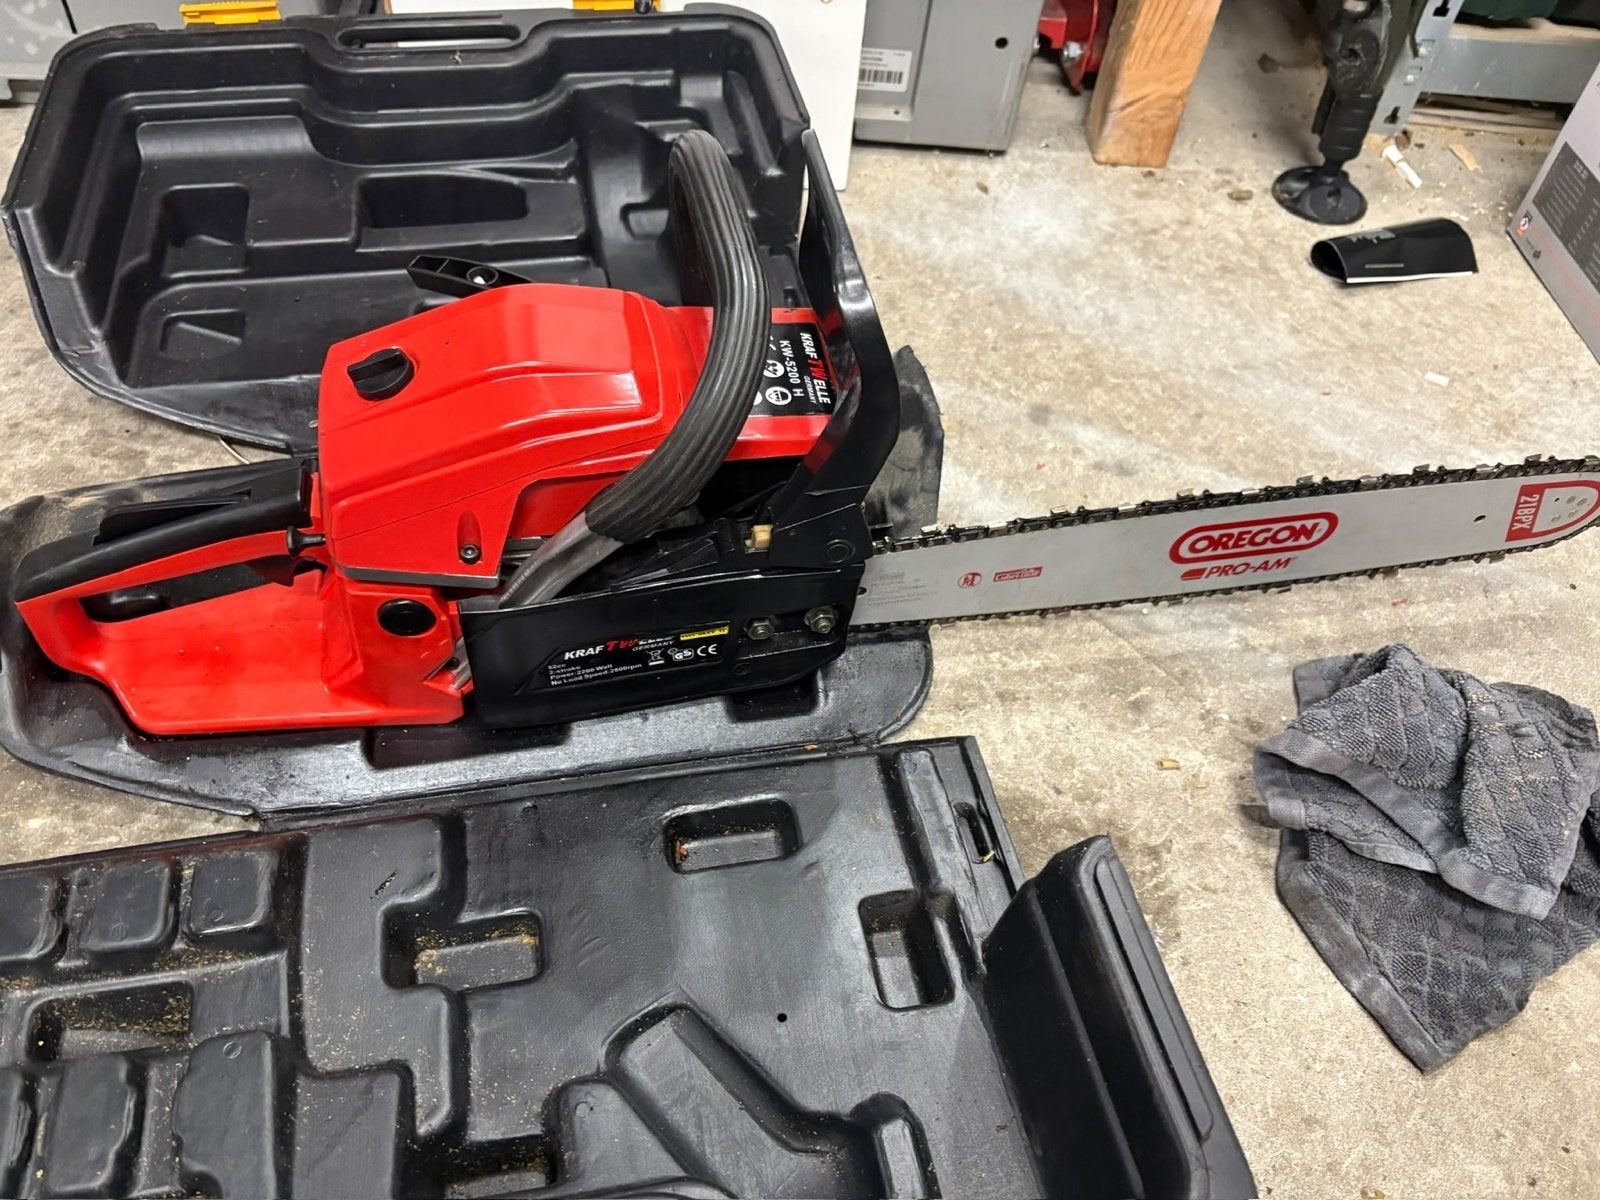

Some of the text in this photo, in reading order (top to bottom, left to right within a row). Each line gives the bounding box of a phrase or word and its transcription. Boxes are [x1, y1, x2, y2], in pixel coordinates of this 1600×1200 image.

[779, 340, 805, 397] KW-5200 H
[800, 332, 832, 405] KRAFTWELLE
[803, 375, 817, 405] GERMANY
[1511, 494, 1540, 530] 21BPX
[1188, 523, 1320, 554] OREGON
[1204, 557, 1291, 579] PRO-AM
[632, 641, 675, 652] GERMANY
[549, 666, 581, 675] 2-stroke
[563, 675, 583, 683] Load
